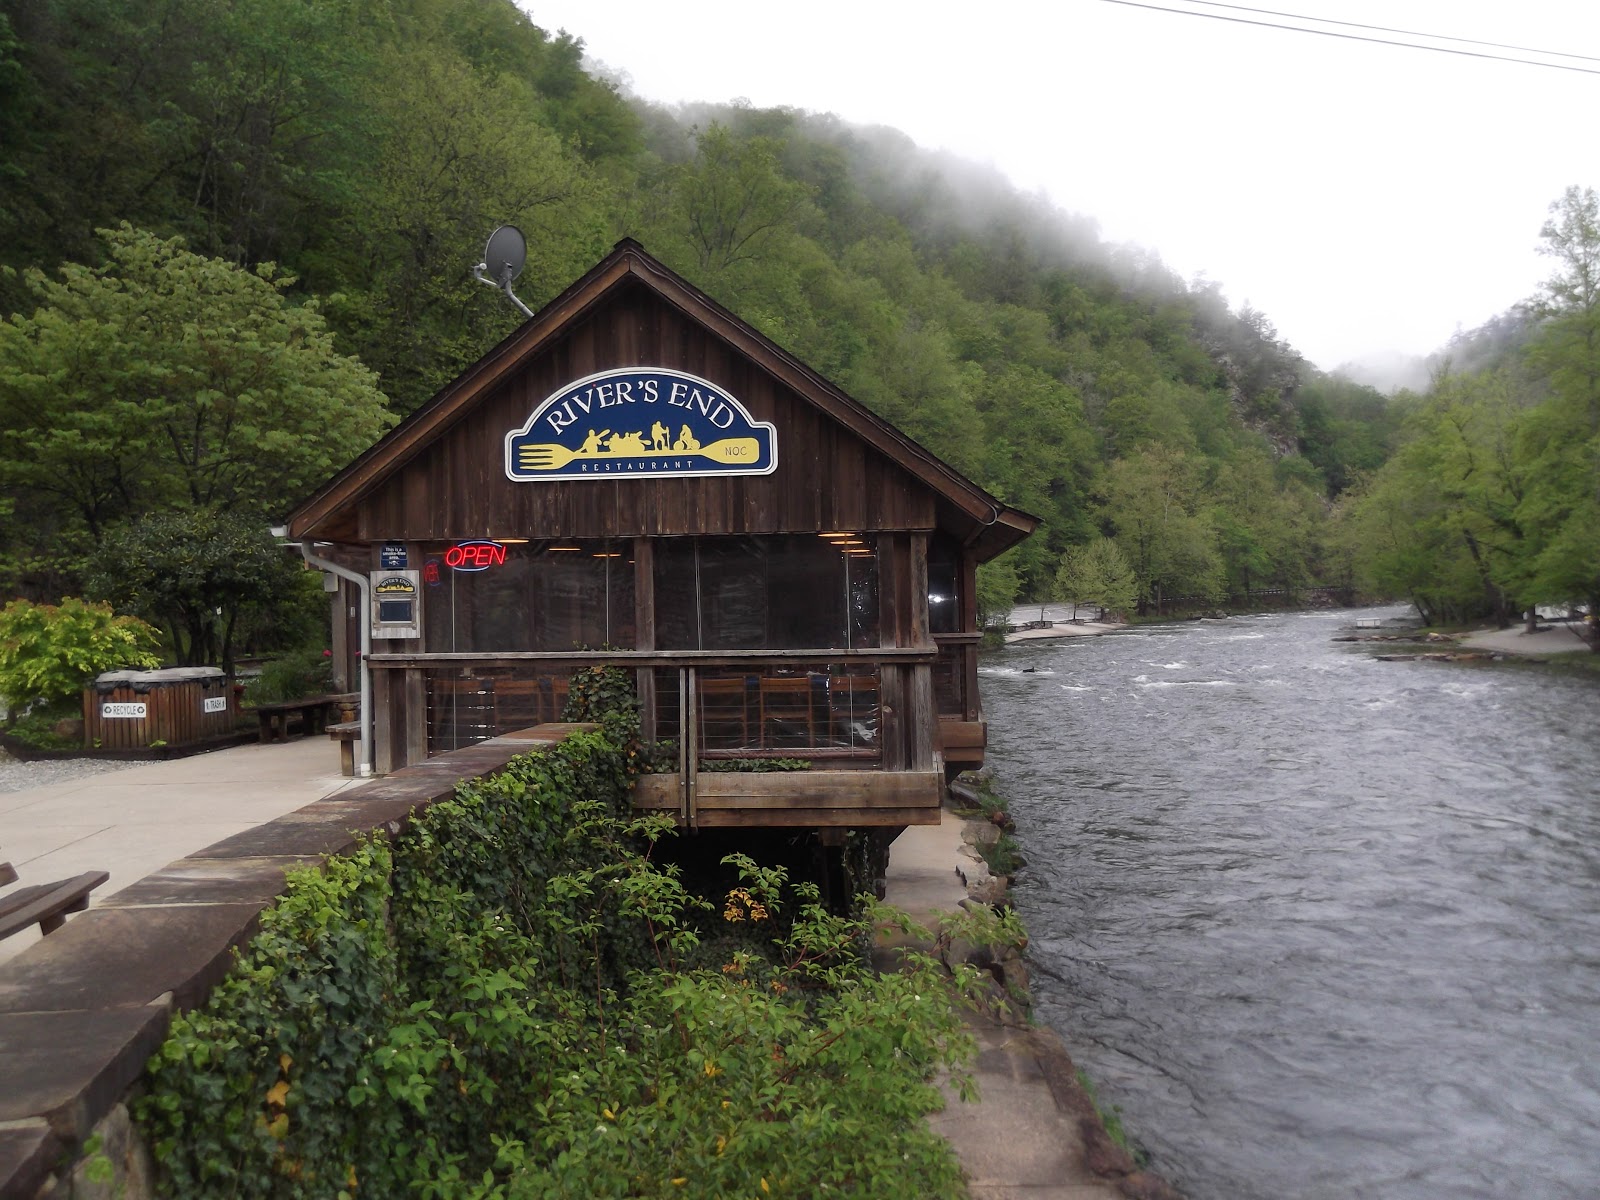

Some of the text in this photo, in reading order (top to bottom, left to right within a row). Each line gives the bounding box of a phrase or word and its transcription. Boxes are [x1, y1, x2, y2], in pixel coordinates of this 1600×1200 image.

[546, 380, 734, 435] RIVER'S END
[725, 446, 747, 457] NOC
[581, 460, 693, 472] RESTAURANT
[446, 546, 506, 567] OPEN
[113, 705, 136, 715] RECYCLE
[210, 700, 221, 709] TRASH
